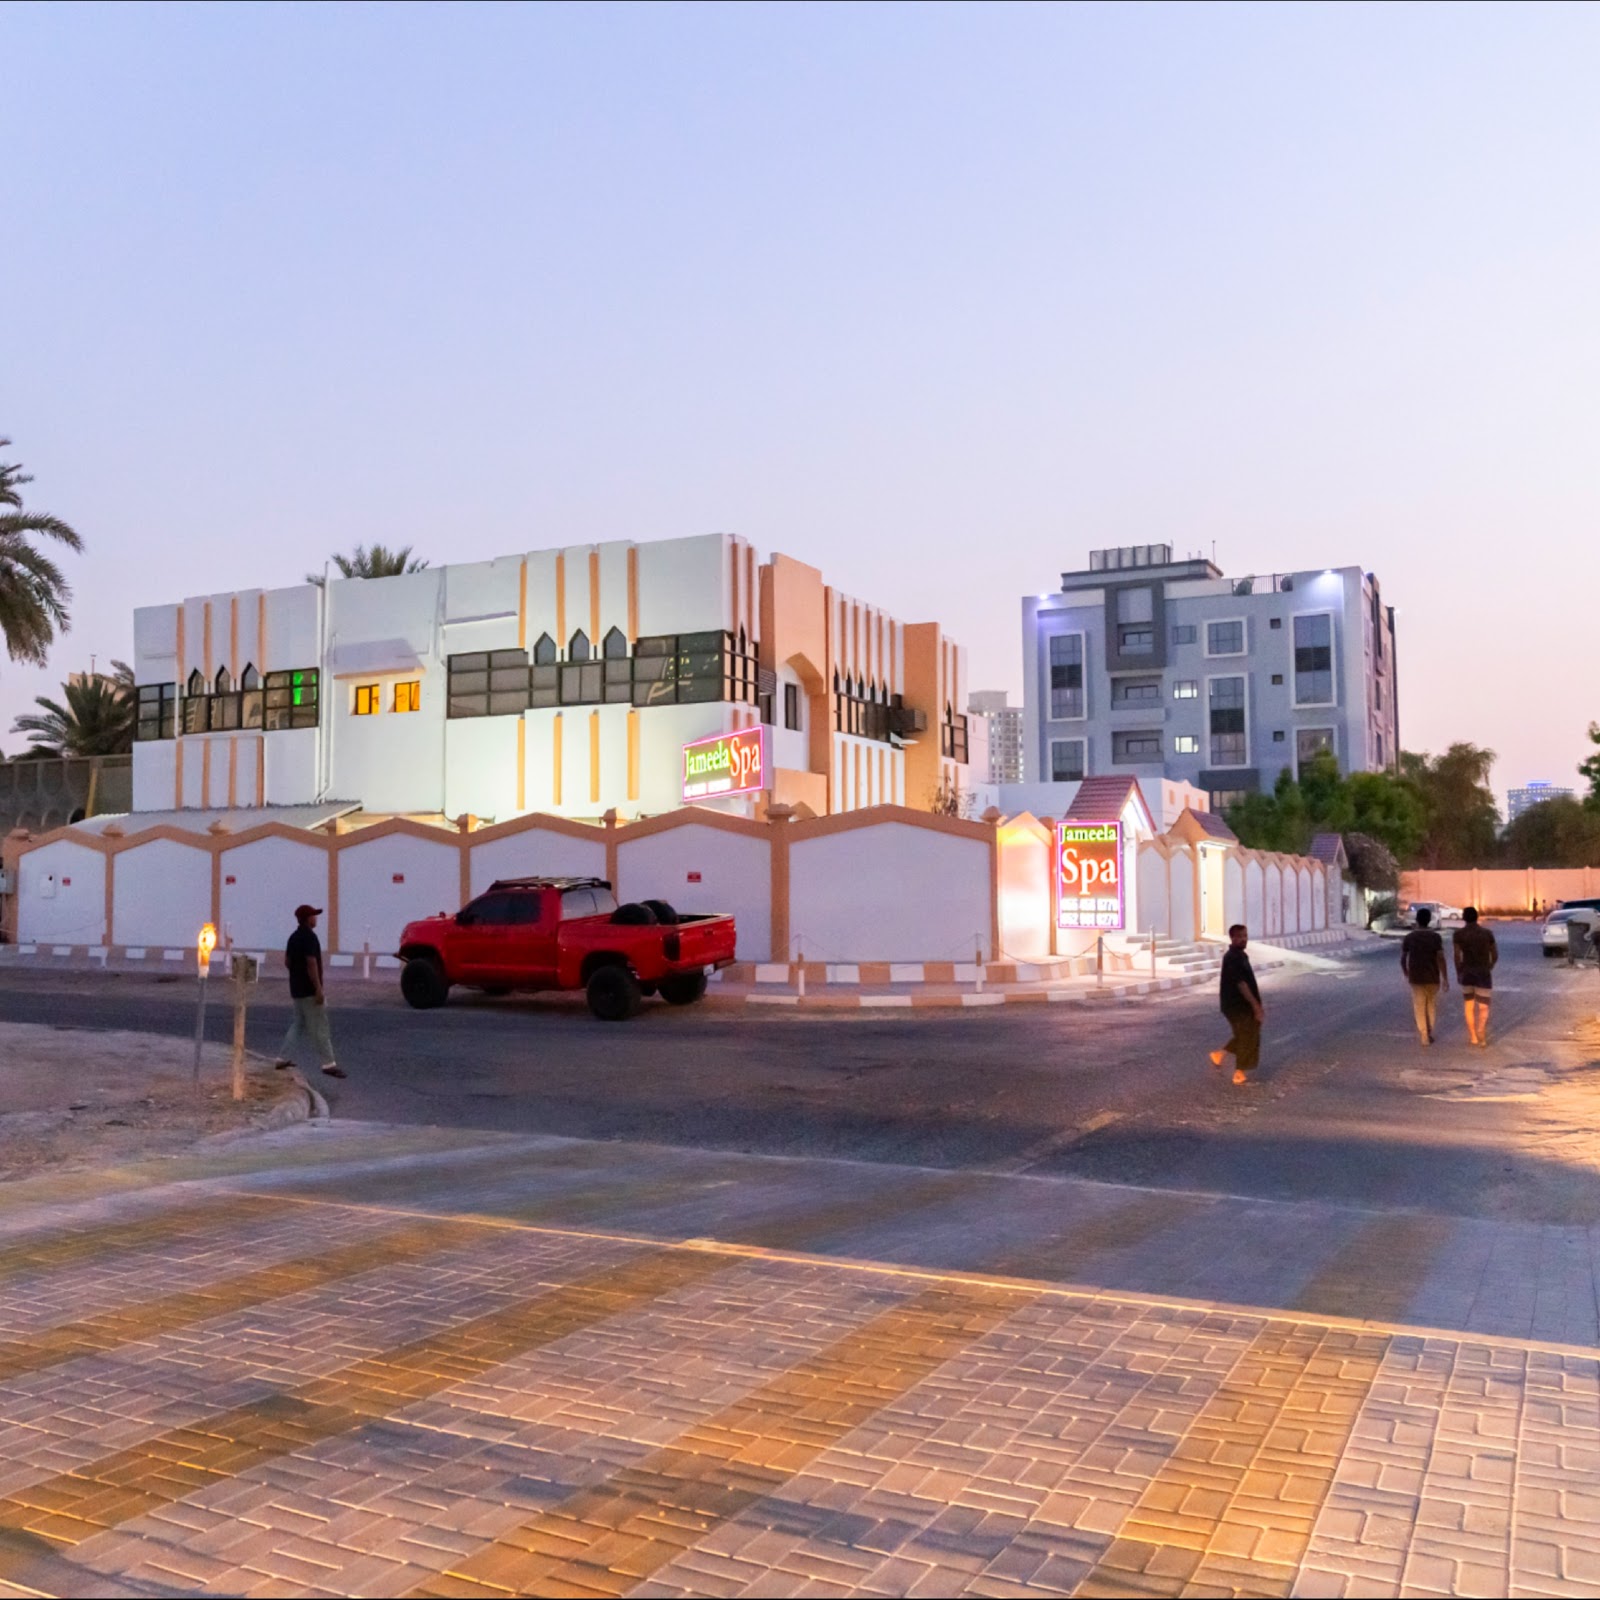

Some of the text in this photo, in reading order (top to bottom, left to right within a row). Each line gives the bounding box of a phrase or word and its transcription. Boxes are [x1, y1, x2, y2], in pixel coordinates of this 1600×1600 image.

[684, 740, 730, 782] Jameela
[730, 736, 761, 788] Spa
[1060, 824, 1118, 845] Jameela
[1061, 847, 1118, 895] Spa
